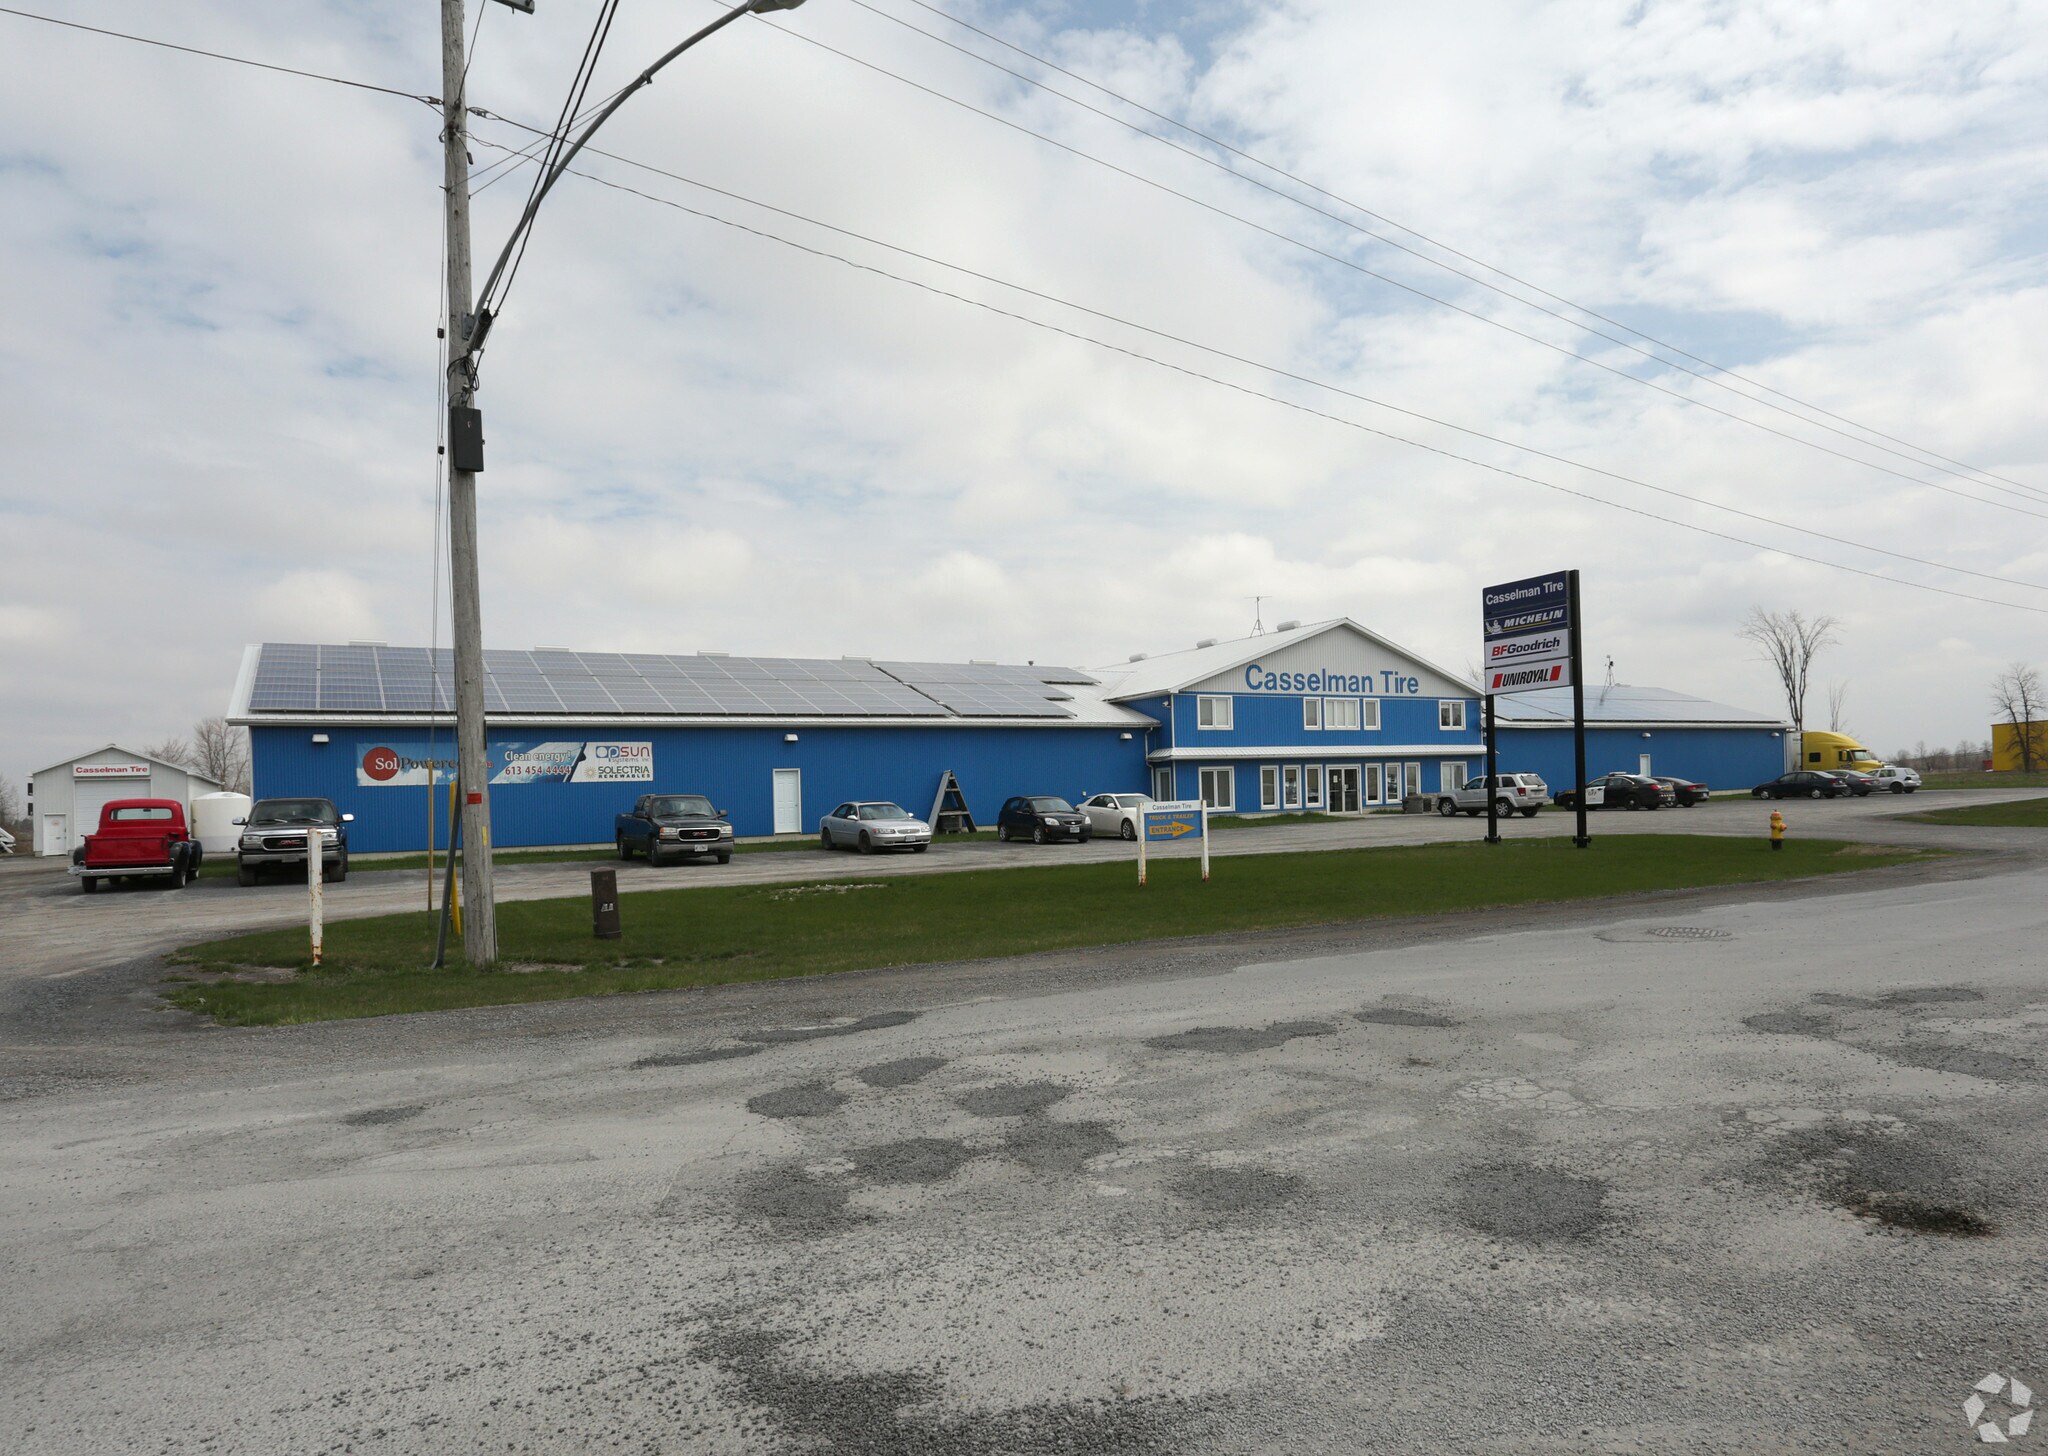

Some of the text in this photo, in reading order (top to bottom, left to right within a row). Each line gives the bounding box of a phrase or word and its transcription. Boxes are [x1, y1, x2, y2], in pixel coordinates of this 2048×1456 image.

[1486, 581, 1565, 605] Casselman Tire
[1503, 609, 1564, 628] MICHELIN
[1491, 637, 1561, 657] BFGoodrich
[1245, 664, 1419, 694] Casselman Tire
[1502, 668, 1550, 687] UNIROYAL
[504, 751, 531, 761] Clean
[75, 765, 148, 774] Casselman Tire
[505, 765, 571, 775] 613 454 4444
[597, 765, 650, 774] SOLECTRIA
